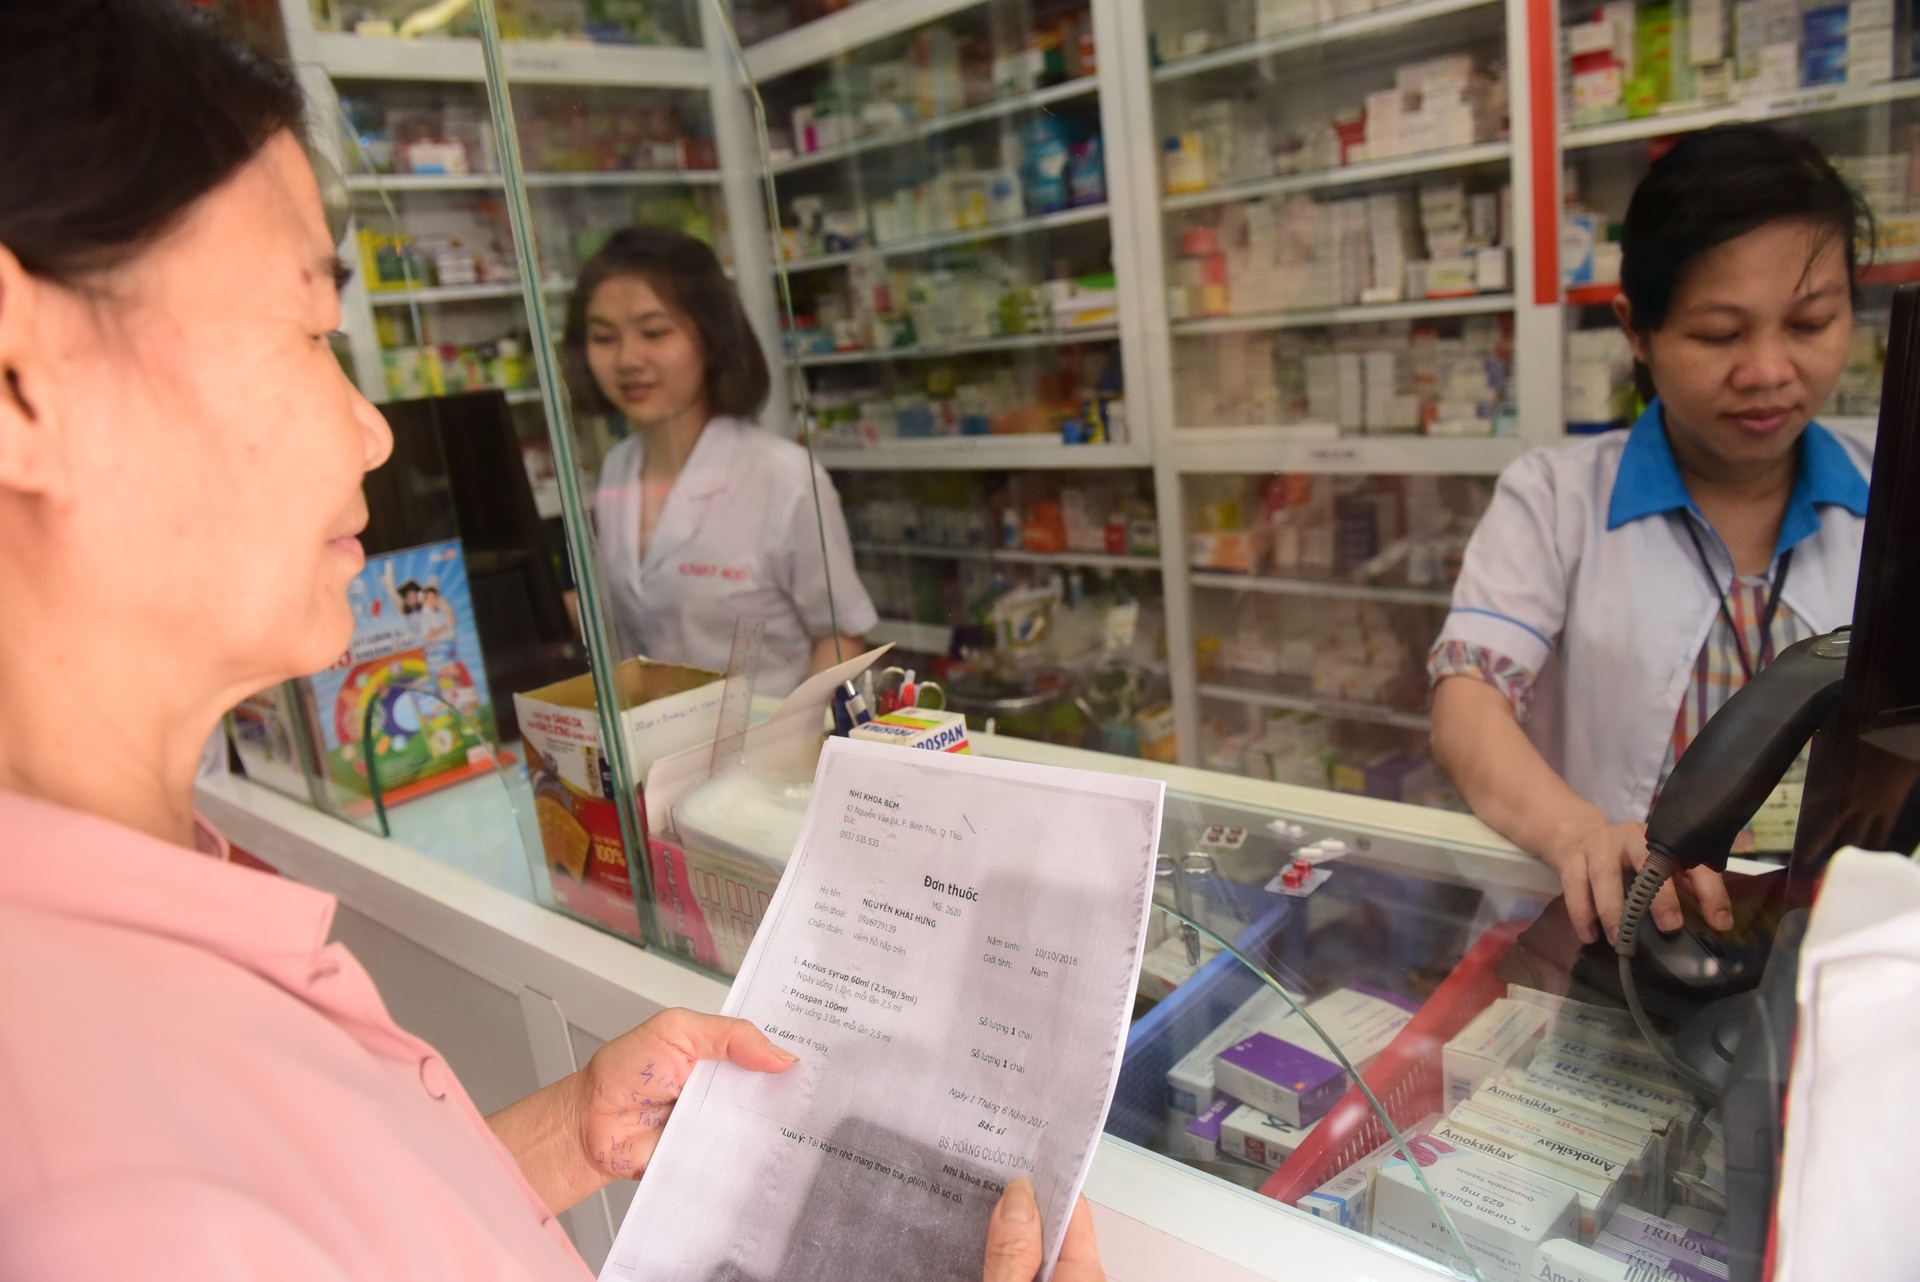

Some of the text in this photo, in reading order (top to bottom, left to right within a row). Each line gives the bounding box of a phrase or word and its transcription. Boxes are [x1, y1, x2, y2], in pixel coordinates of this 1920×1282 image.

[864, 794, 882, 805] KHOA
[884, 799, 900, 810] BCM
[840, 830, 880, 847] 0937 535 535
[940, 828, 946, 838] Q.
[820, 885, 843, 899] Họ tên:
[924, 875, 979, 902] Đơn thuốc
[814, 902, 848, 918] Điện thoại:
[932, 901, 962, 917] Mã: 2620
[826, 922, 845, 936] đoán:
[857, 915, 897, 934] 0916729139
[915, 915, 936, 928] HƯNG
[987, 936, 1078, 966] Năm sinh: 10/10/2016
[794, 956, 800, 964] 1.
[801, 959, 827, 974] Aerius
[828, 969, 849, 982] syrup
[850, 976, 870, 988] 60ml
[983, 954, 996, 964] Giới
[1030, 966, 1048, 978] Nam
[790, 988, 822, 1006] Prospan
[824, 1000, 848, 1013] 100ml
[796, 971, 815, 985] Ngày
[816, 978, 833, 991] uống
[881, 1000, 891, 1010] 2,5
[892, 1004, 902, 1013] ml
[785, 1000, 804, 1014] Ngày
[804, 1007, 822, 1021] uống
[870, 1028, 881, 1039] 2,5
[882, 1033, 892, 1042] ml
[978, 1016, 1033, 1040] Số lượng 1 chai
[764, 1024, 779, 1034] Lời
[813, 1041, 829, 1053] ngày
[971, 1048, 981, 1058] Số
[981, 1052, 1000, 1067] lượng
[1009, 1062, 1025, 1074] chai
[949, 1087, 969, 1103] Ngày
[977, 1097, 1000, 1114] Tháng
[1001, 1106, 1008, 1115] 6
[1009, 1109, 1026, 1122] Năm
[1487, 1083, 1559, 1114] Amoksiklav
[978, 1120, 995, 1132] Bác
[1555, 1120, 1570, 1130] 625
[1571, 1125, 1586, 1136] mg
[938, 1136, 980, 1158] BS.HOÀNG
[982, 1147, 1006, 1165] QUỐC
[1439, 1128, 1515, 1160] Amoksiklav
[1537, 1138, 1616, 1173] Amoksiklav
[799, 1133, 806, 1143] ý:
[808, 1136, 818, 1147] Tái
[820, 1141, 838, 1155] khám
[839, 1148, 852, 1160] nhớ
[853, 1155, 873, 1170] mang
[874, 1161, 890, 1175] theo
[930, 1182, 940, 1194] hồ
[941, 1189, 952, 1198] sơ
[1456, 1167, 1485, 1182] Tablets
[943, 1164, 1004, 1194] Nhi khoa BCM
[1487, 1180, 1534, 1202] Dispersible
[1460, 1185, 1480, 1198] mg
[1482, 1195, 1504, 1208] 625
[1477, 1204, 1516, 1225] Curam
